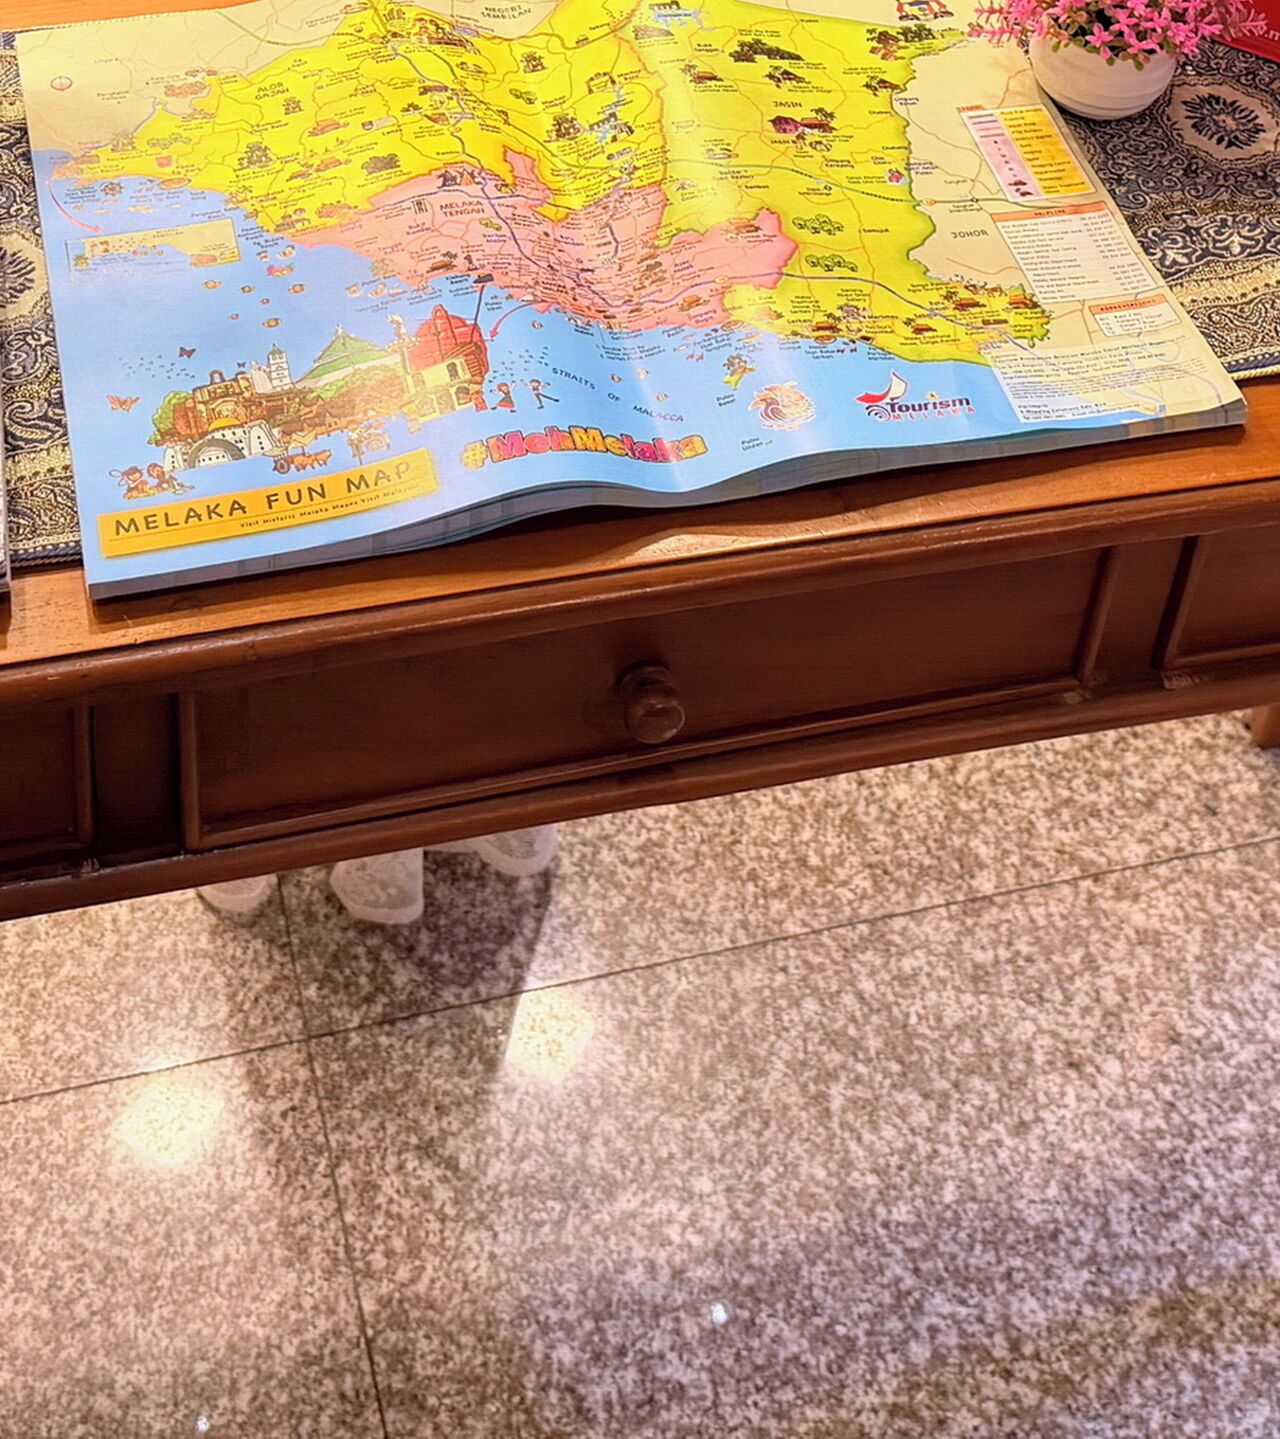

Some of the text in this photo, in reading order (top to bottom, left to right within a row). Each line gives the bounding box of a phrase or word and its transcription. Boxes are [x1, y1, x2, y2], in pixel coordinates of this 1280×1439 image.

[773, 101, 803, 109] JASIN
[439, 200, 485, 212] MELAKA
[442, 207, 486, 217] TENGAH
[950, 230, 989, 239] JOHOR
[552, 368, 684, 422] STRAITS OF MALACCA
[886, 396, 970, 413] Tourism
[890, 407, 975, 421] MELAKA
[114, 462, 412, 536] MELAKA FUN MAP
